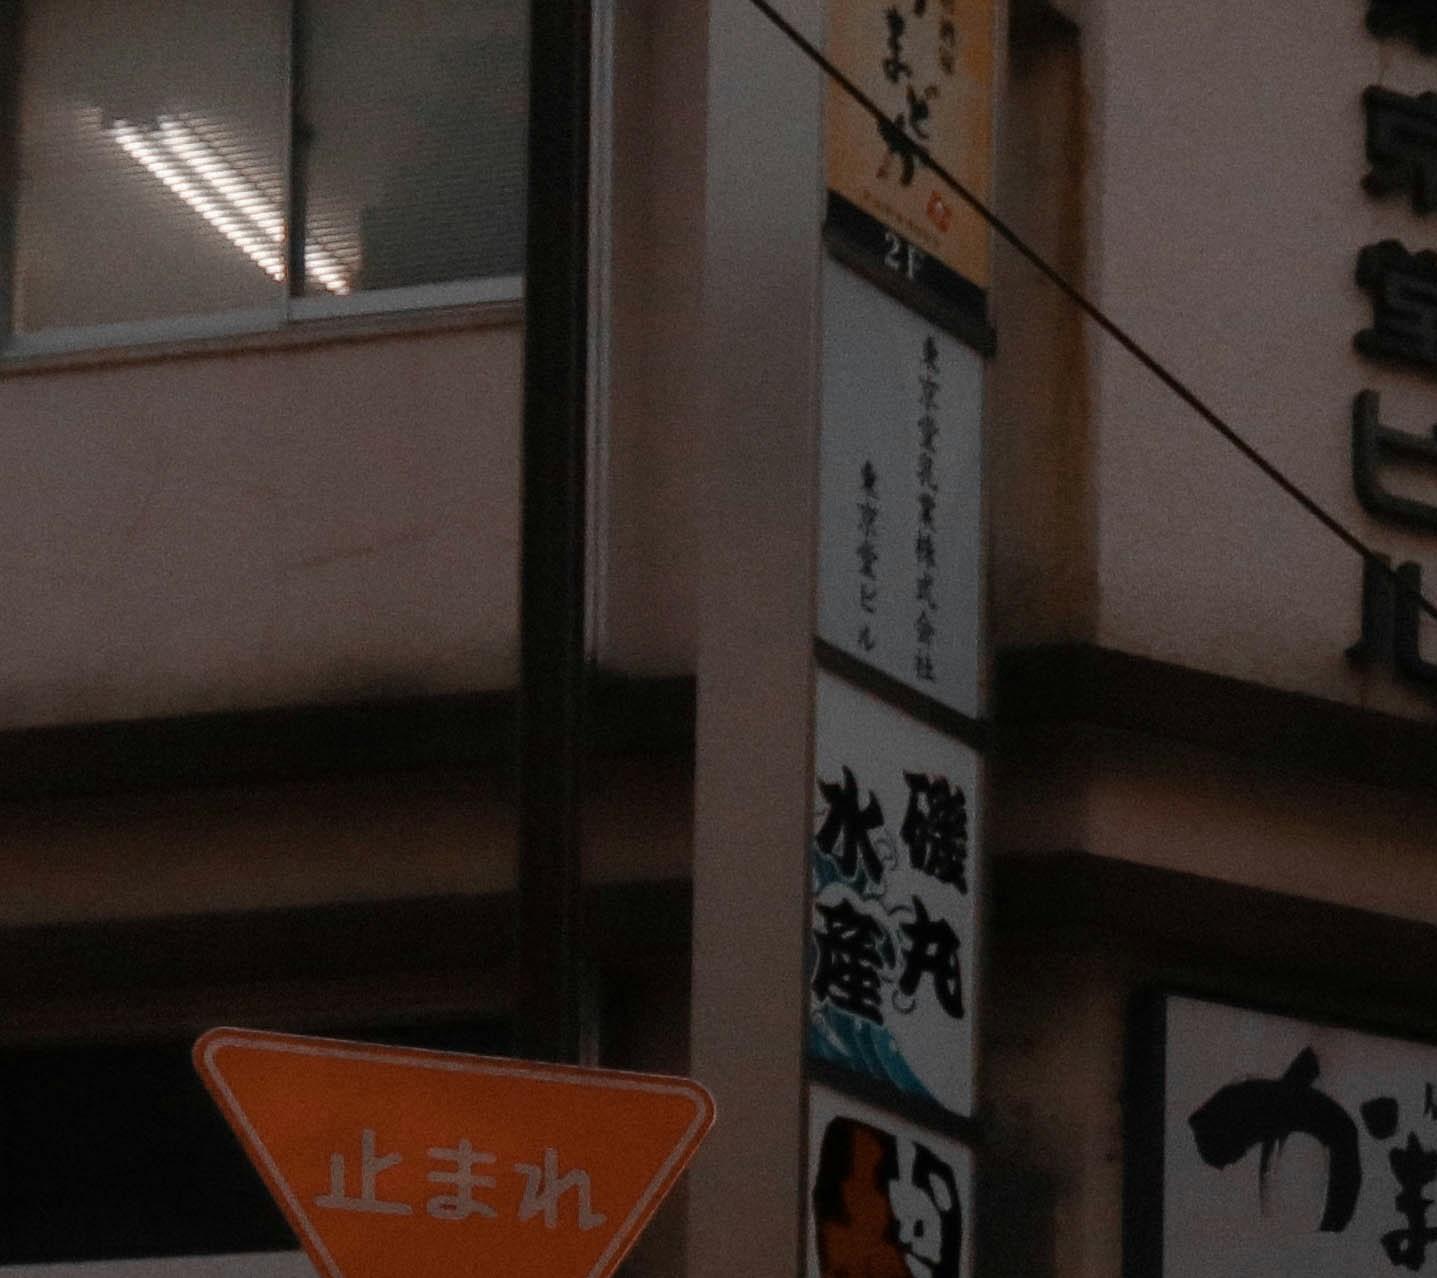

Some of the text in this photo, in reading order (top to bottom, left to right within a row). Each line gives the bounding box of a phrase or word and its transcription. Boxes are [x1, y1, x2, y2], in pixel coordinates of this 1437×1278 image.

[884, 229, 922, 281] 2F
[813, 769, 972, 1025] 磯丸 水産
[314, 1128, 607, 1230] 止まれ
